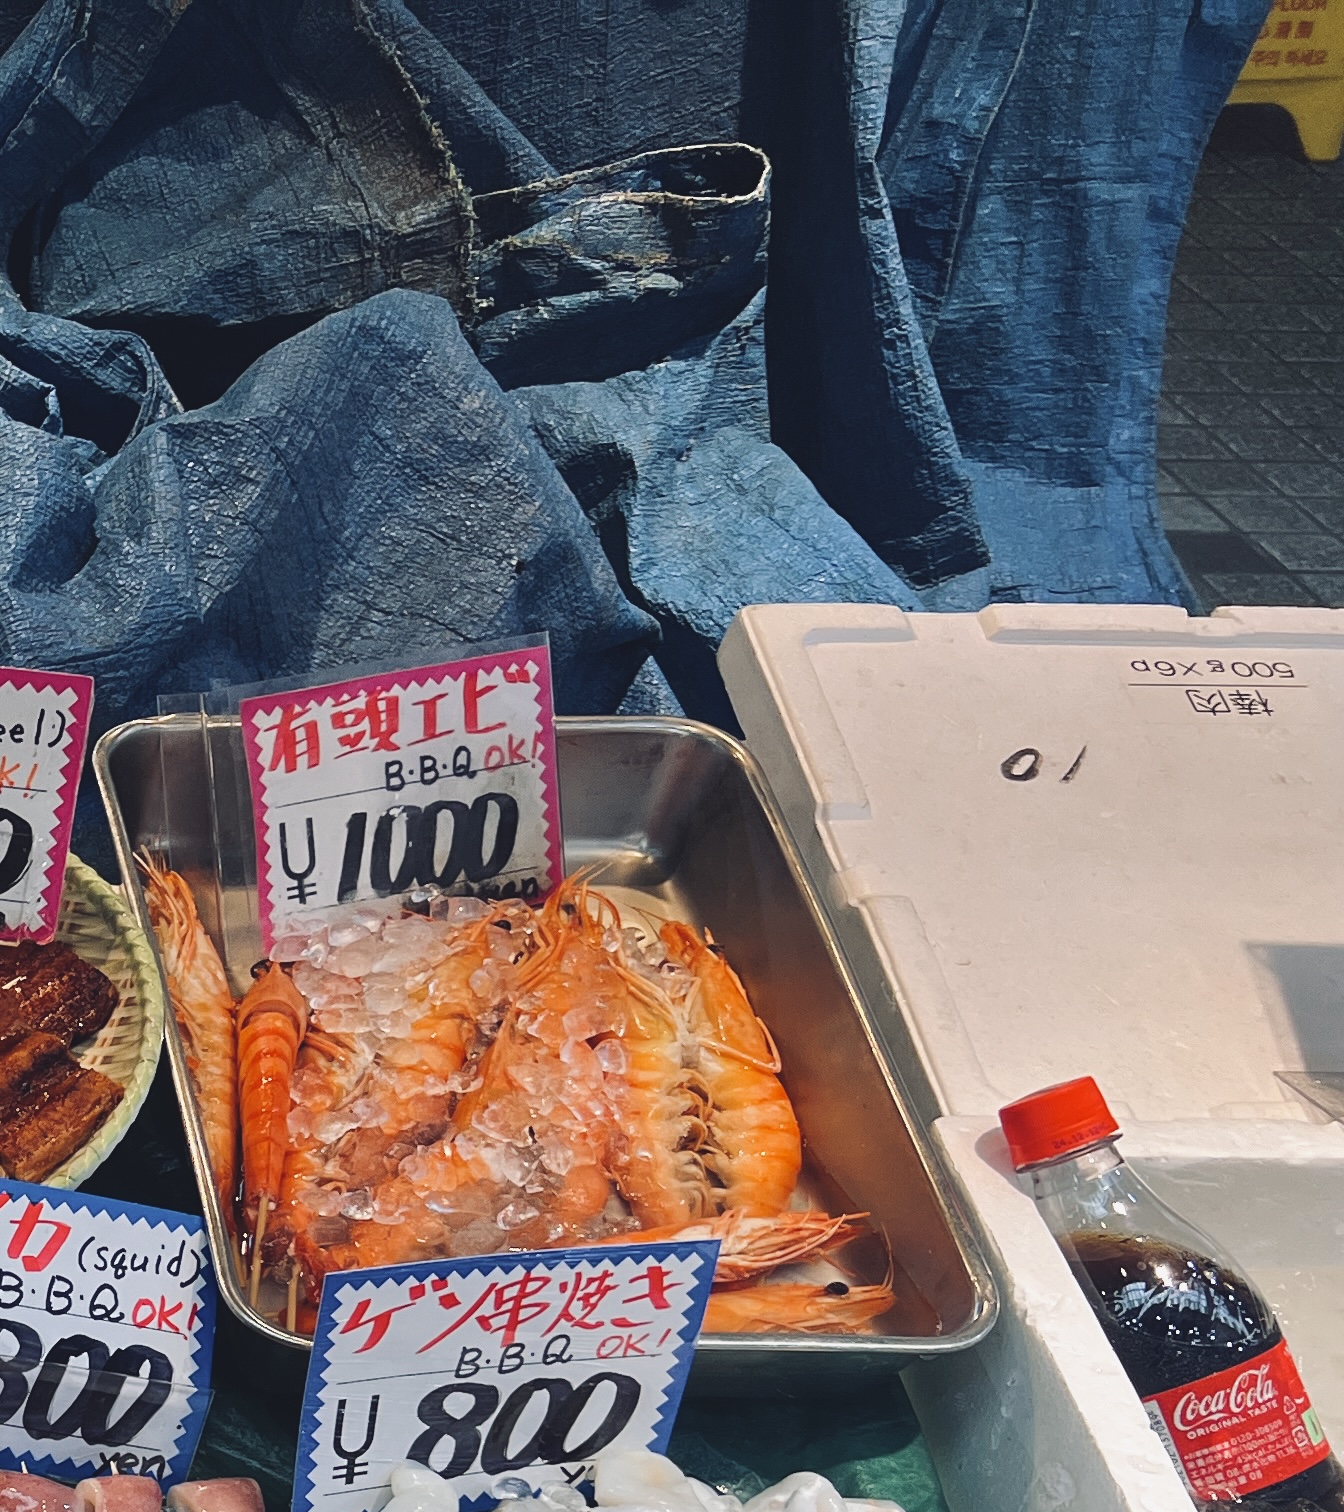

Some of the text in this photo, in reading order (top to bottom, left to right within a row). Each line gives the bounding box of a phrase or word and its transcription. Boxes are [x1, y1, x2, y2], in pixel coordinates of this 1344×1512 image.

[263, 666, 533, 776] 有頭エビ
[484, 731, 543, 773] OK!
[77, 1235, 203, 1288] (squid)
[339, 1264, 686, 1355] ゲソ串焼き
[595, 1327, 673, 1360] OK!
[1172, 1362, 1276, 1432] Coca-Cola
[1186, 1399, 1280, 1441] ORIGINAL TASTE
[96, 1450, 166, 1480] yen
